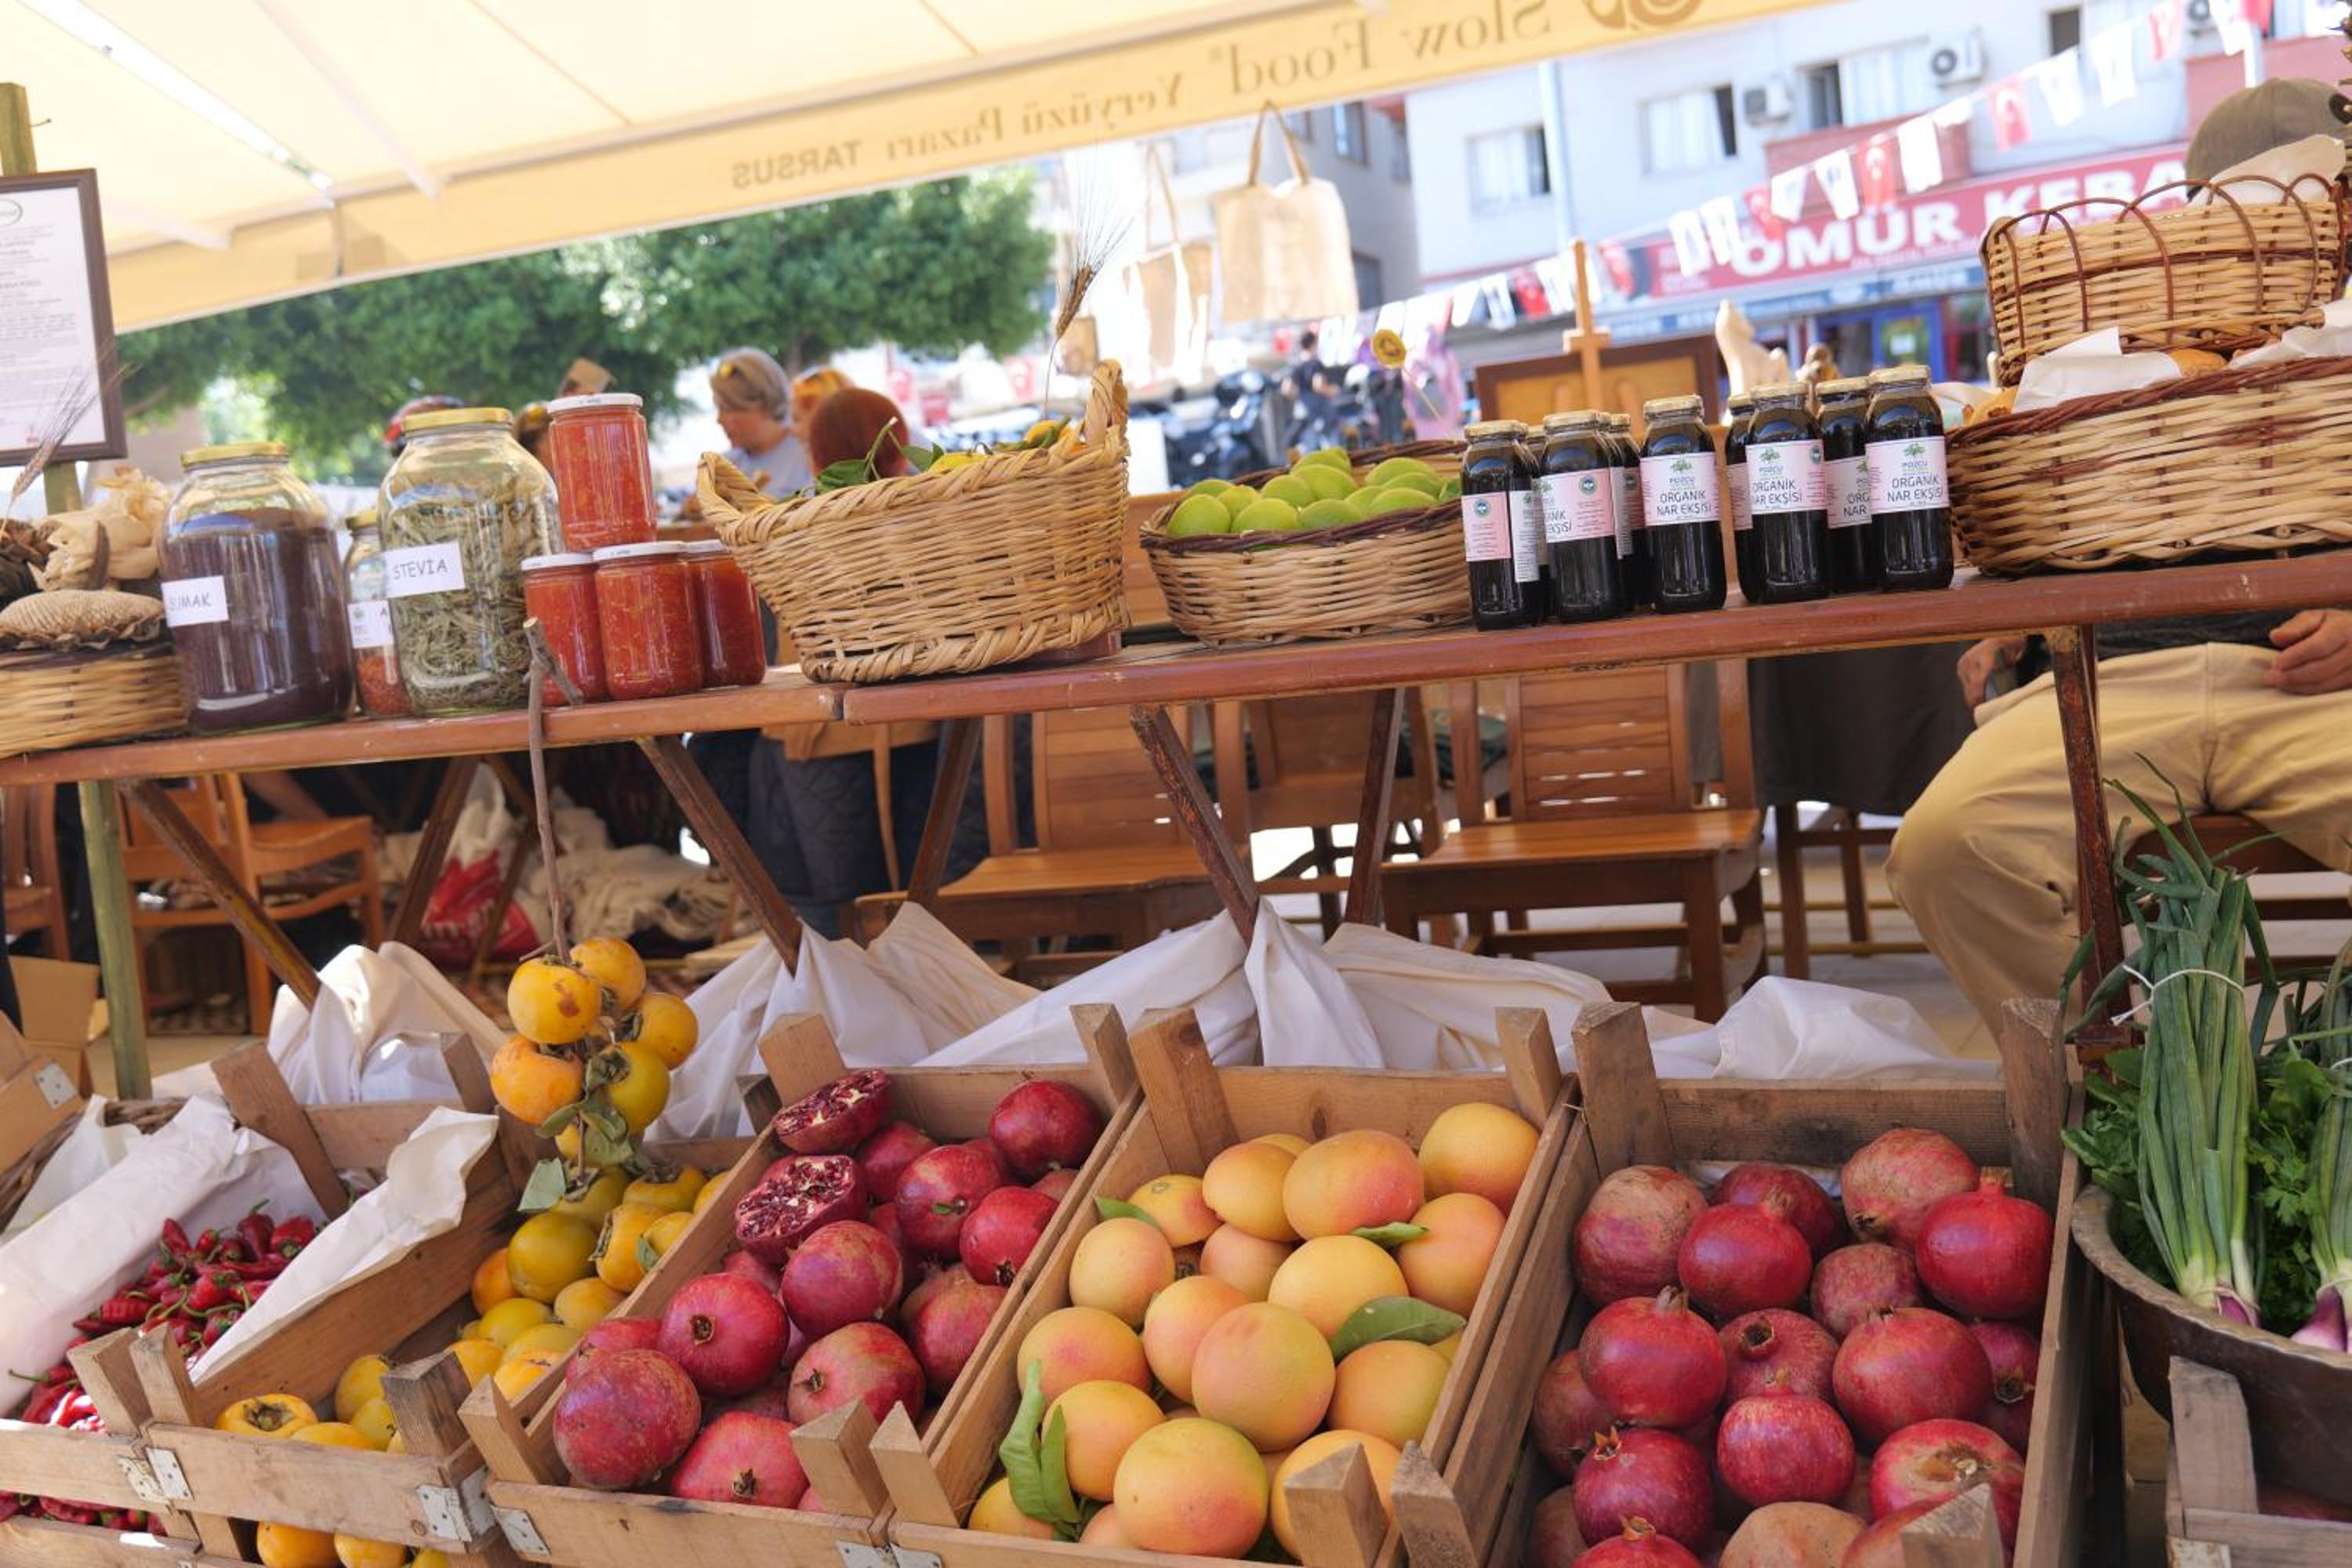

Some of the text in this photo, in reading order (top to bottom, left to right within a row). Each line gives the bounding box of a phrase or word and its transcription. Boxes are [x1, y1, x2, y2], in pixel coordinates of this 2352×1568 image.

[1983, 158, 2188, 230] KEBA
[1887, 489, 1911, 503] NAR
[1656, 503, 1679, 516] NAR
[1843, 504, 1867, 517] NAR
